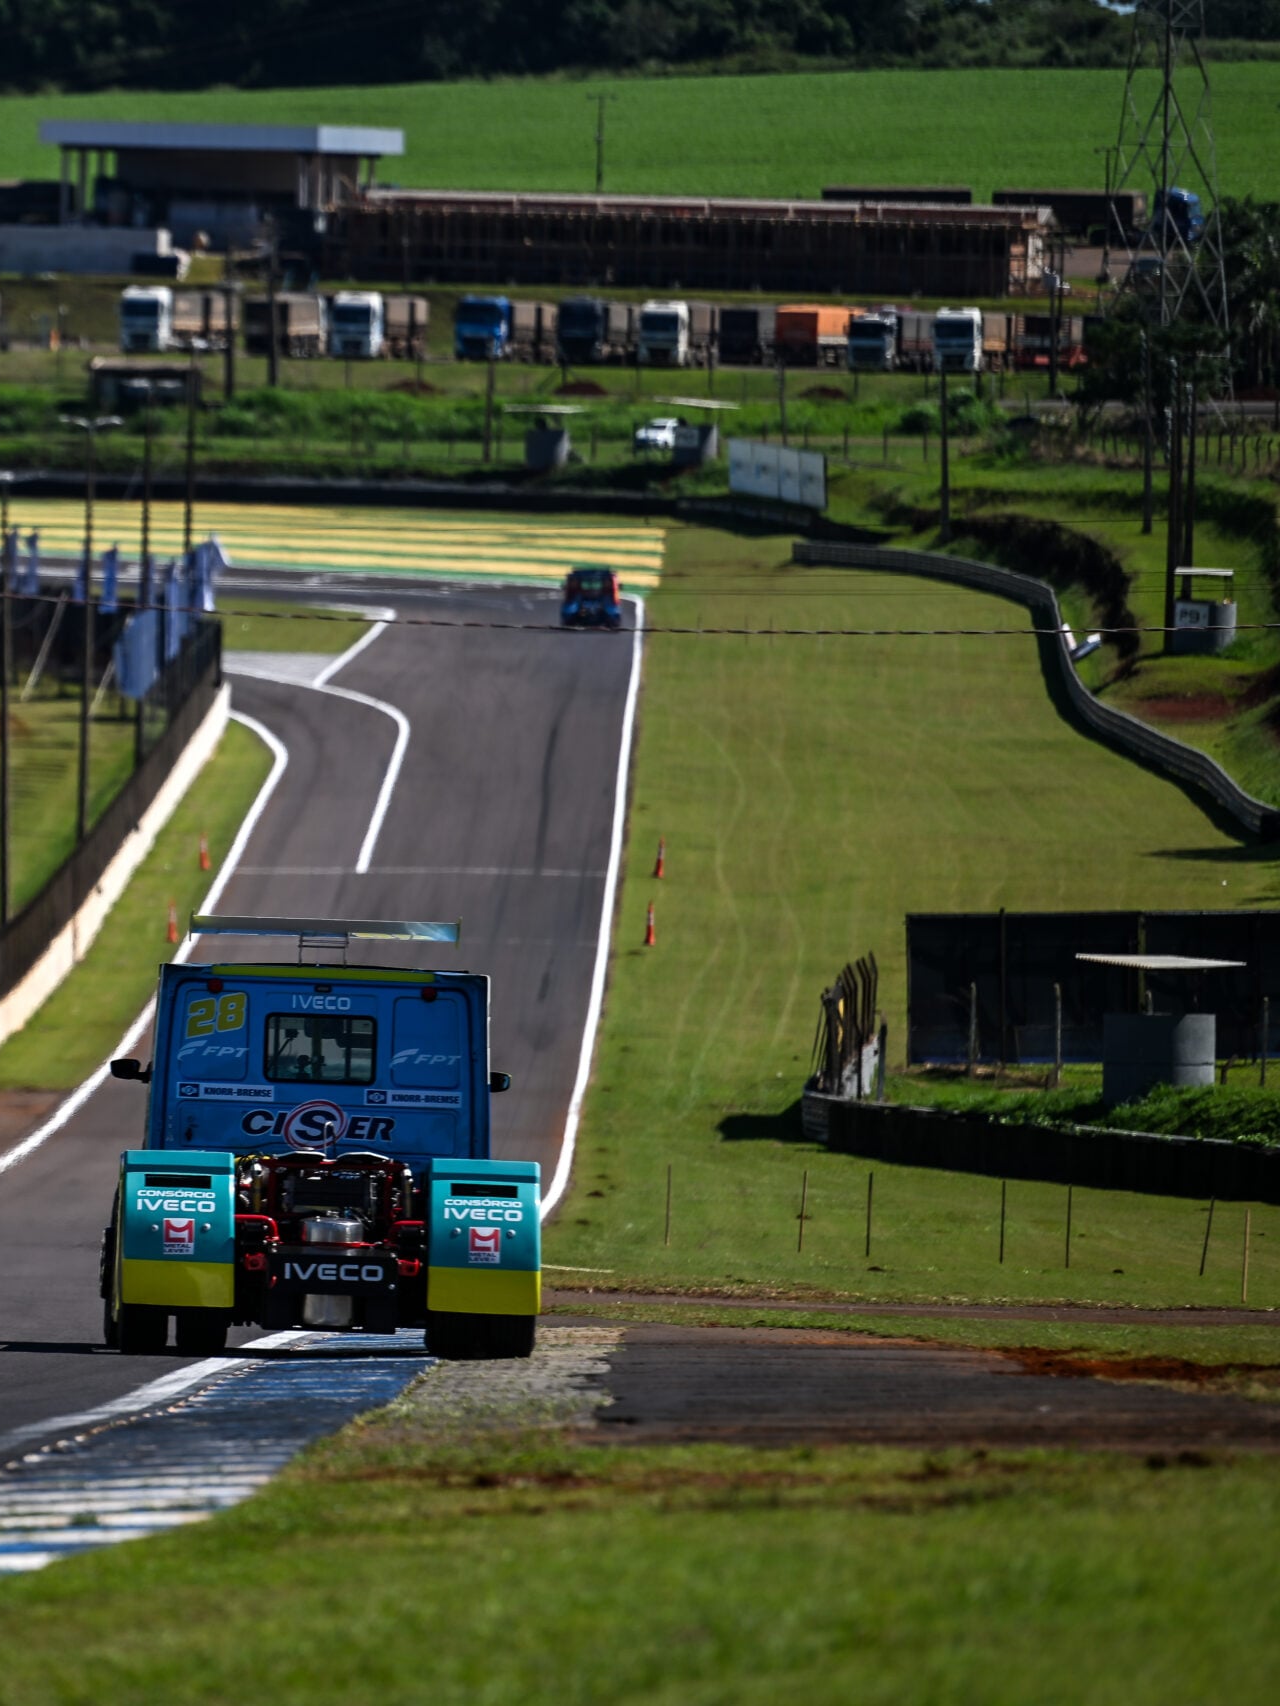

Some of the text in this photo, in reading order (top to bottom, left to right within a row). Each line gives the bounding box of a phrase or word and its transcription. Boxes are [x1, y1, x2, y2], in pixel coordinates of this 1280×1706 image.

[291, 994, 351, 1011] IVECO
[186, 992, 247, 1039] 28
[202, 1045, 250, 1058] FPT
[413, 1054, 462, 1066] FPT
[203, 1086, 273, 1099] KNORR-BREMSE
[391, 1093, 461, 1106] KNORR-BREMSE
[241, 1105, 395, 1144] CISER
[137, 1189, 216, 1199] CONSÓRCIO
[136, 1199, 216, 1213] IVECO
[444, 1198, 523, 1208] CONSÓRCIO
[443, 1207, 524, 1222] IVECO
[283, 1263, 384, 1282] IVECO
